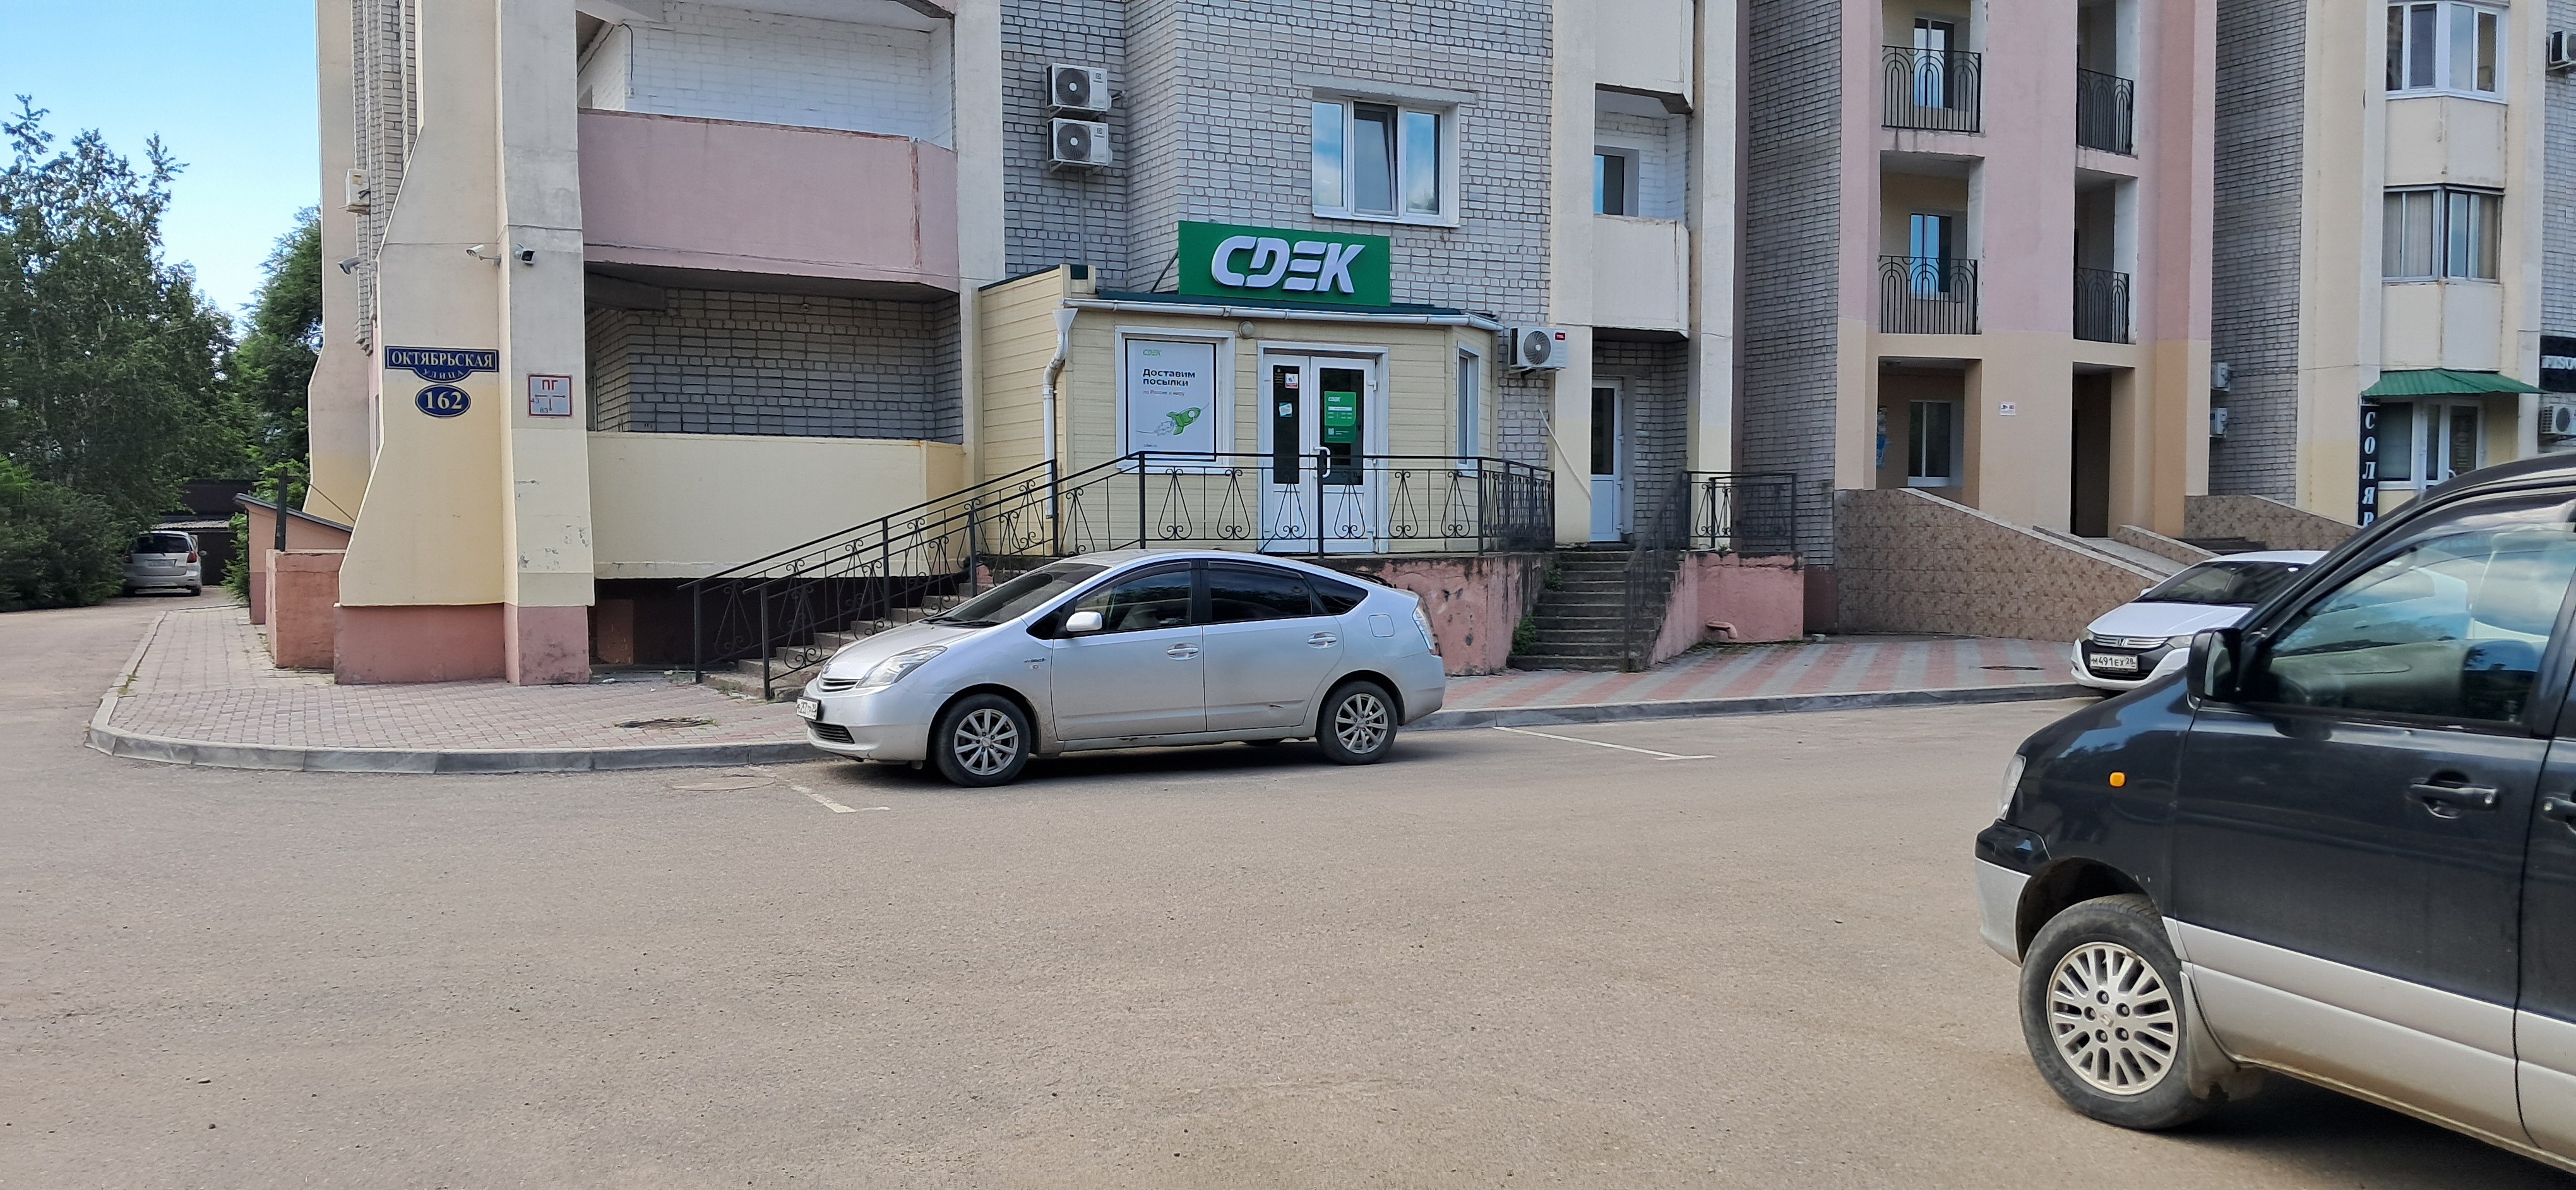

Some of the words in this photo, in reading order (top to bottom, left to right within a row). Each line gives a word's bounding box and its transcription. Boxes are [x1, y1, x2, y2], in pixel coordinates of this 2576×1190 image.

[1211, 236, 1366, 294] CDEK
[391, 351, 493, 368] ОКТЯБРЬСКАЯ
[422, 368, 464, 379] УЛИЦА
[1143, 368, 1196, 378] Доставим
[542, 380, 558, 390] ПГ
[426, 391, 463, 410] 162
